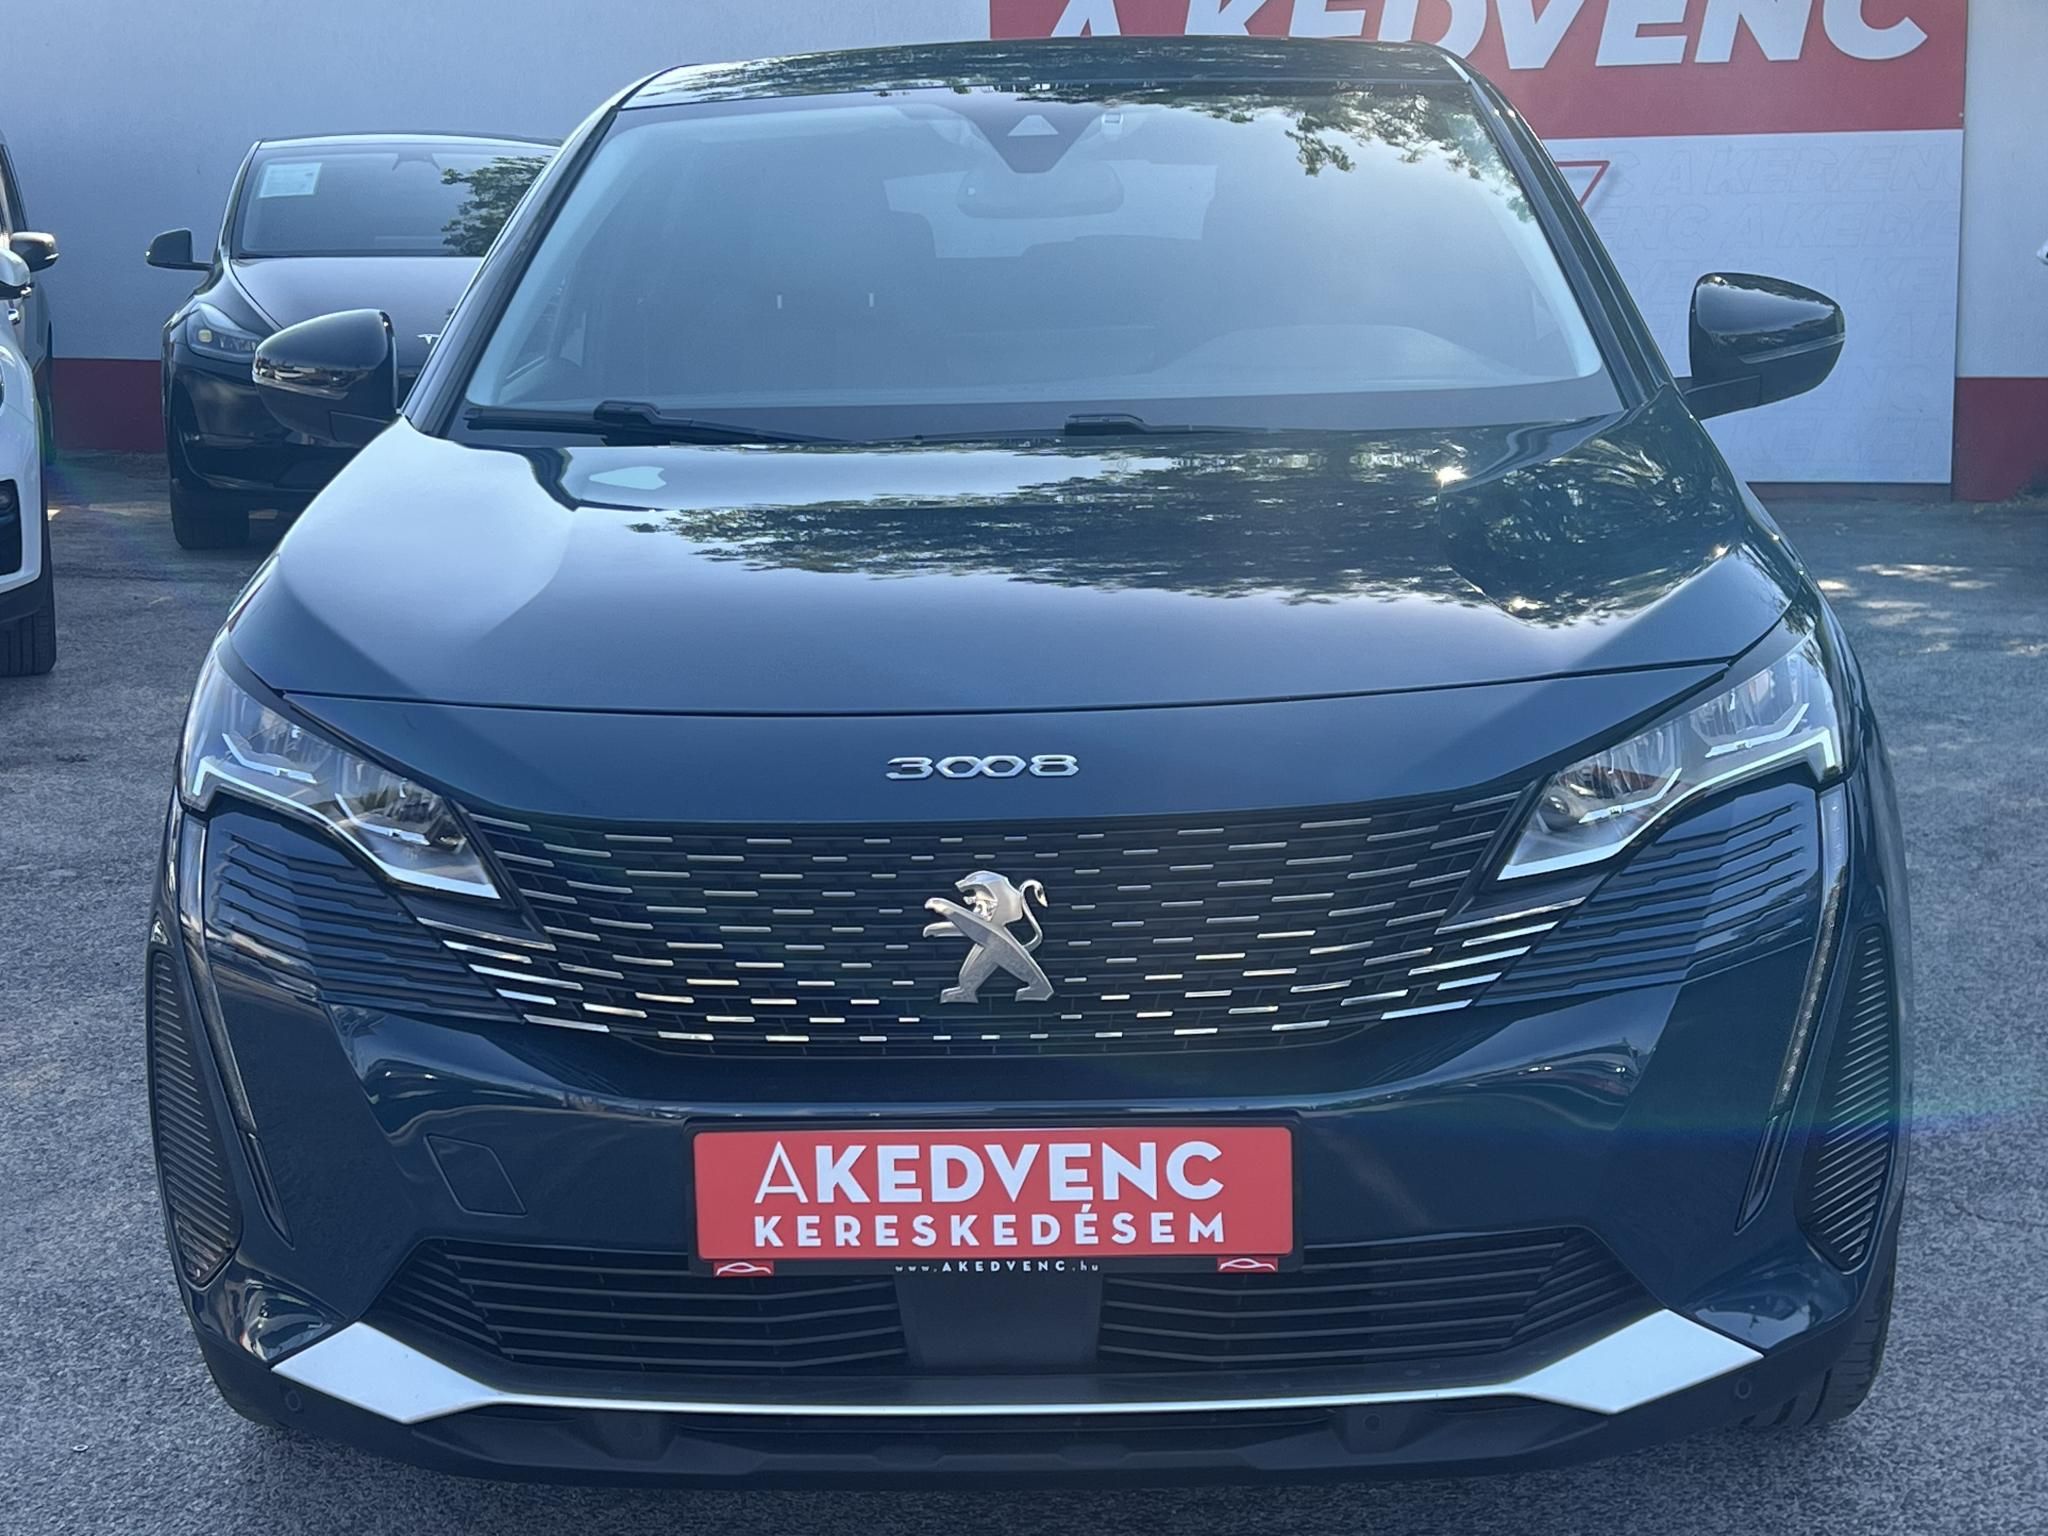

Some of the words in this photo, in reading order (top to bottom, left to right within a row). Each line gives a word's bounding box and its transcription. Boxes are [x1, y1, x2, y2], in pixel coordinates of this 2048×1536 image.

[886, 754, 1079, 780] 3008
[754, 1204, 1225, 1247] KERESKEDÉSEM
[895, 1260, 1099, 1273] www.AKEDVENC.hu
